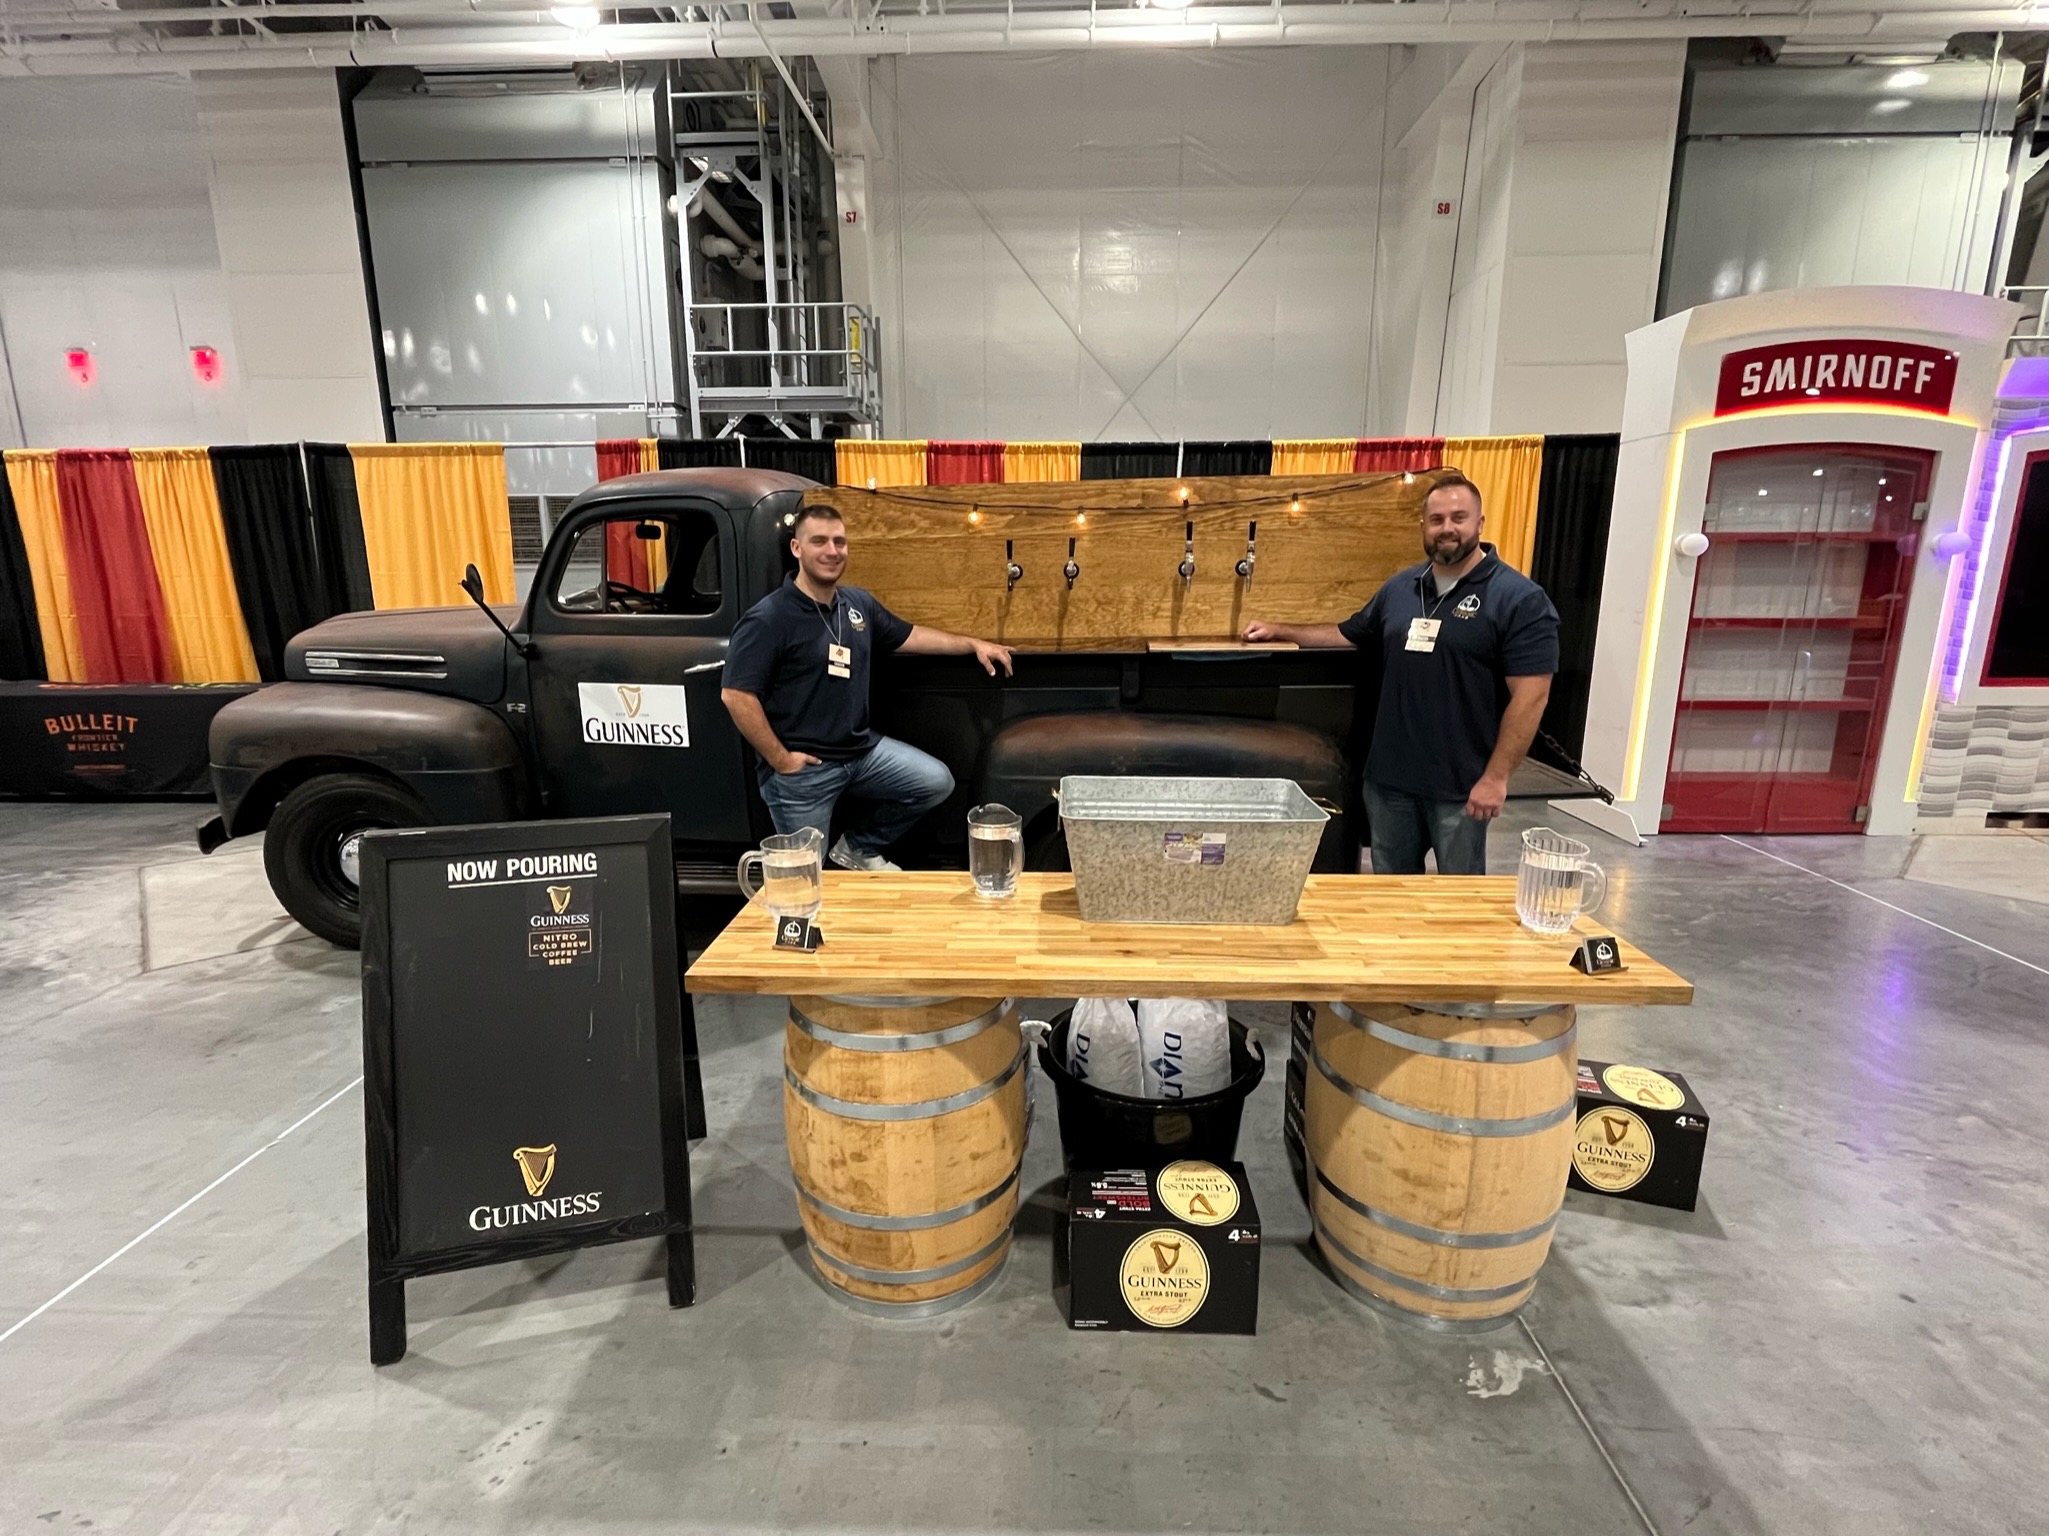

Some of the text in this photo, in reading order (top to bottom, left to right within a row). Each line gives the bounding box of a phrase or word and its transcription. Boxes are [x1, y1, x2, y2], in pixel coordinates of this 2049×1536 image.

[1437, 202, 1450, 215] S8
[845, 211, 857, 223] S7
[1740, 353, 1936, 397] SMIRNOFF
[44, 713, 139, 735] BULLEIT
[585, 717, 684, 746] GUINNESS
[447, 853, 598, 882] NOW POURING
[530, 914, 590, 927] GUINNESS
[543, 933, 578, 942] NITRO
[533, 940, 588, 951] COLD BREW
[542, 949, 578, 958] COFFEE
[548, 957, 573, 966] BEER
[1675, 1115, 1687, 1128] 4
[1577, 1141, 1647, 1163] GUINNESS
[1587, 1156, 1609, 1166] EXTRA
[1163, 1182, 1231, 1193] GUINNESS
[468, 1192, 601, 1231] GUINNESS
[1094, 1208, 1106, 1219] 4
[1228, 1229, 1240, 1241] 4
[1128, 1274, 1202, 1289] GUINNESS
